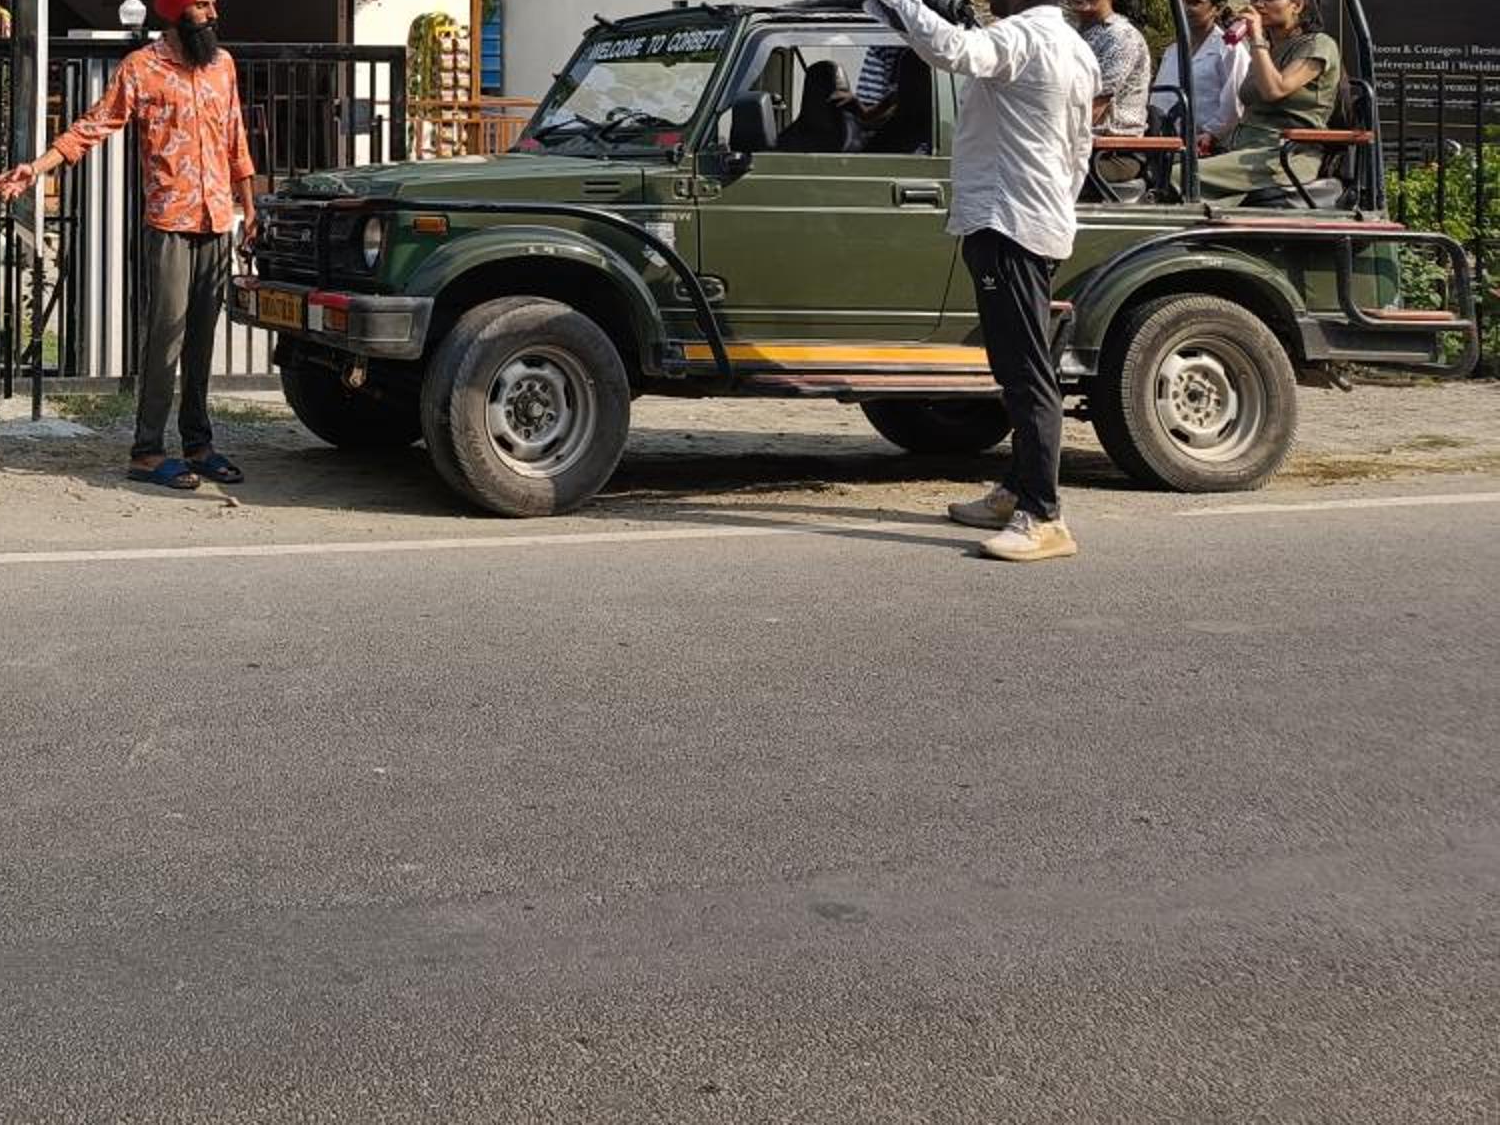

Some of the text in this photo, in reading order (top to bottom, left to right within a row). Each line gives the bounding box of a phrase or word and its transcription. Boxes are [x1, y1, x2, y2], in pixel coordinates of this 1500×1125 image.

[588, 29, 726, 60] WELCOME TO CORBETT
